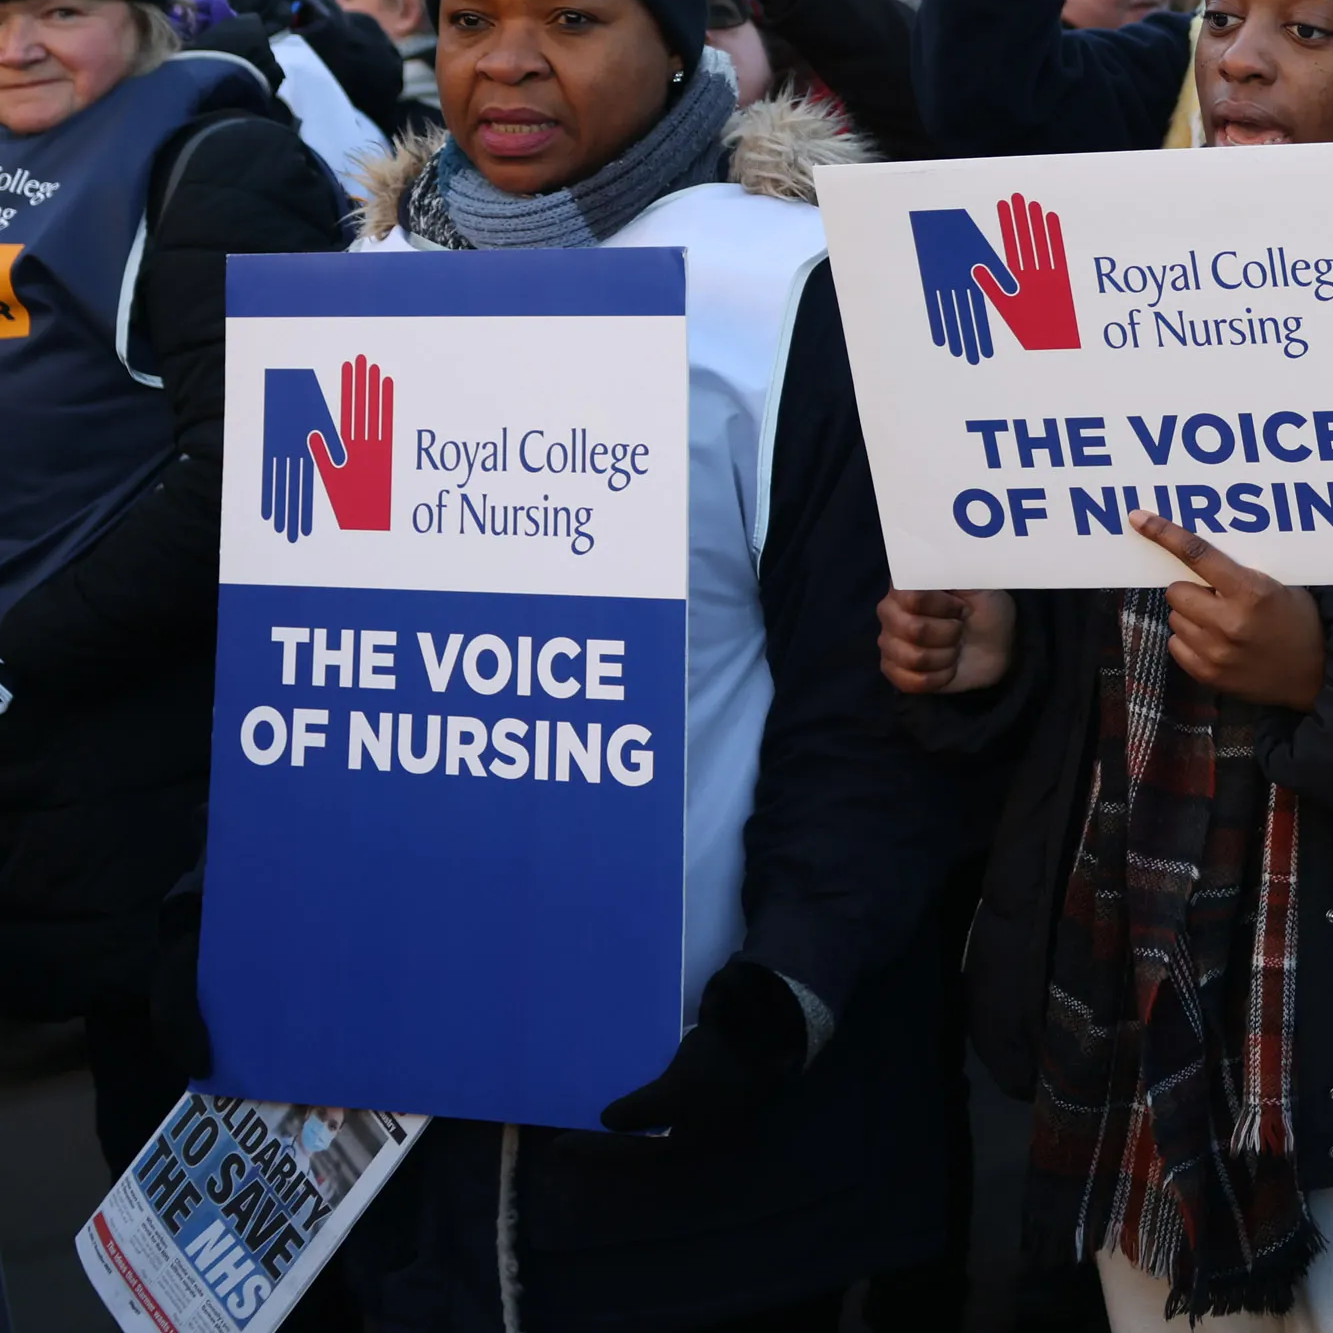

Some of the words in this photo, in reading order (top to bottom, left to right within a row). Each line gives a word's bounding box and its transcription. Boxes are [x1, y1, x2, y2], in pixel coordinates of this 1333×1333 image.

[0, 166, 61, 206] ollege
[1093, 249, 1202, 308] Royal
[1102, 309, 1143, 349] of
[1153, 307, 1309, 359] Nursing
[415, 427, 508, 489] Royal
[518, 427, 650, 492] College
[965, 416, 1113, 469] THE
[412, 489, 450, 533] of
[459, 493, 595, 556] Nursing
[952, 487, 1048, 539] OF
[271, 626, 398, 690] THE
[416, 631, 625, 701] VOICE
[239, 705, 330, 767] OF
[347, 710, 654, 788] NURSING
[171, 1094, 220, 1168] TO
[204, 1153, 305, 1281] SAVE
[136, 1136, 203, 1236] THE
[184, 1218, 272, 1322] NHS
